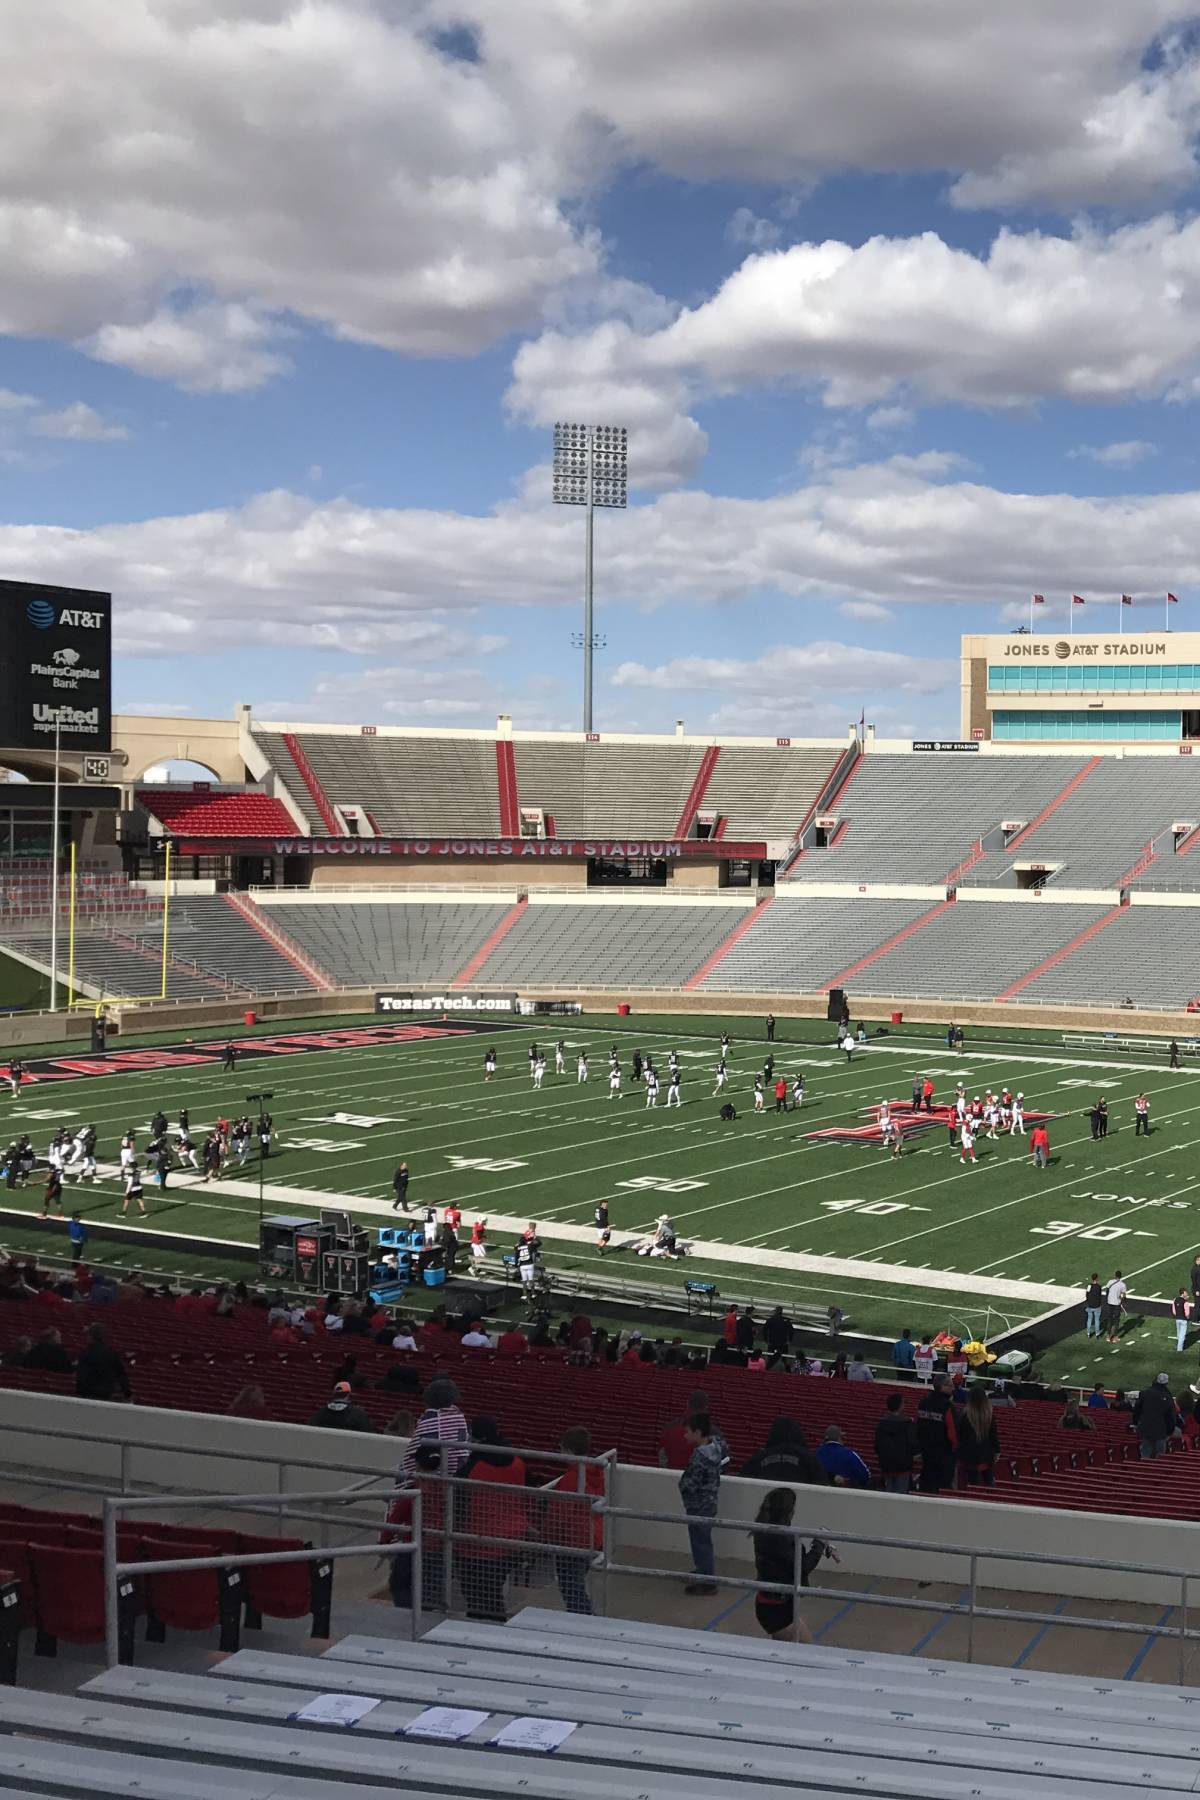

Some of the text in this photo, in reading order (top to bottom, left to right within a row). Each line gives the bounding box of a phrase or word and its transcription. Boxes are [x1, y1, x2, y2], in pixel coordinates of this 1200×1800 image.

[59, 609, 105, 628] AT&T
[1004, 643, 1166, 656] JONES AT&T STADIUM
[30, 663, 100, 680] PlainsCapital
[53, 677, 79, 689] Bank
[33, 703, 98, 724] United
[87, 760, 107, 776] 40
[274, 840, 682, 857] WELCOME TO JONES AT&T STADIUM
[380, 996, 511, 1010] TexasTech.com
[614, 1176, 710, 1192] 50
[819, 1199, 912, 1215] 40
[1070, 1192, 1192, 1209] JONES
[1029, 1220, 1133, 1241] 30
